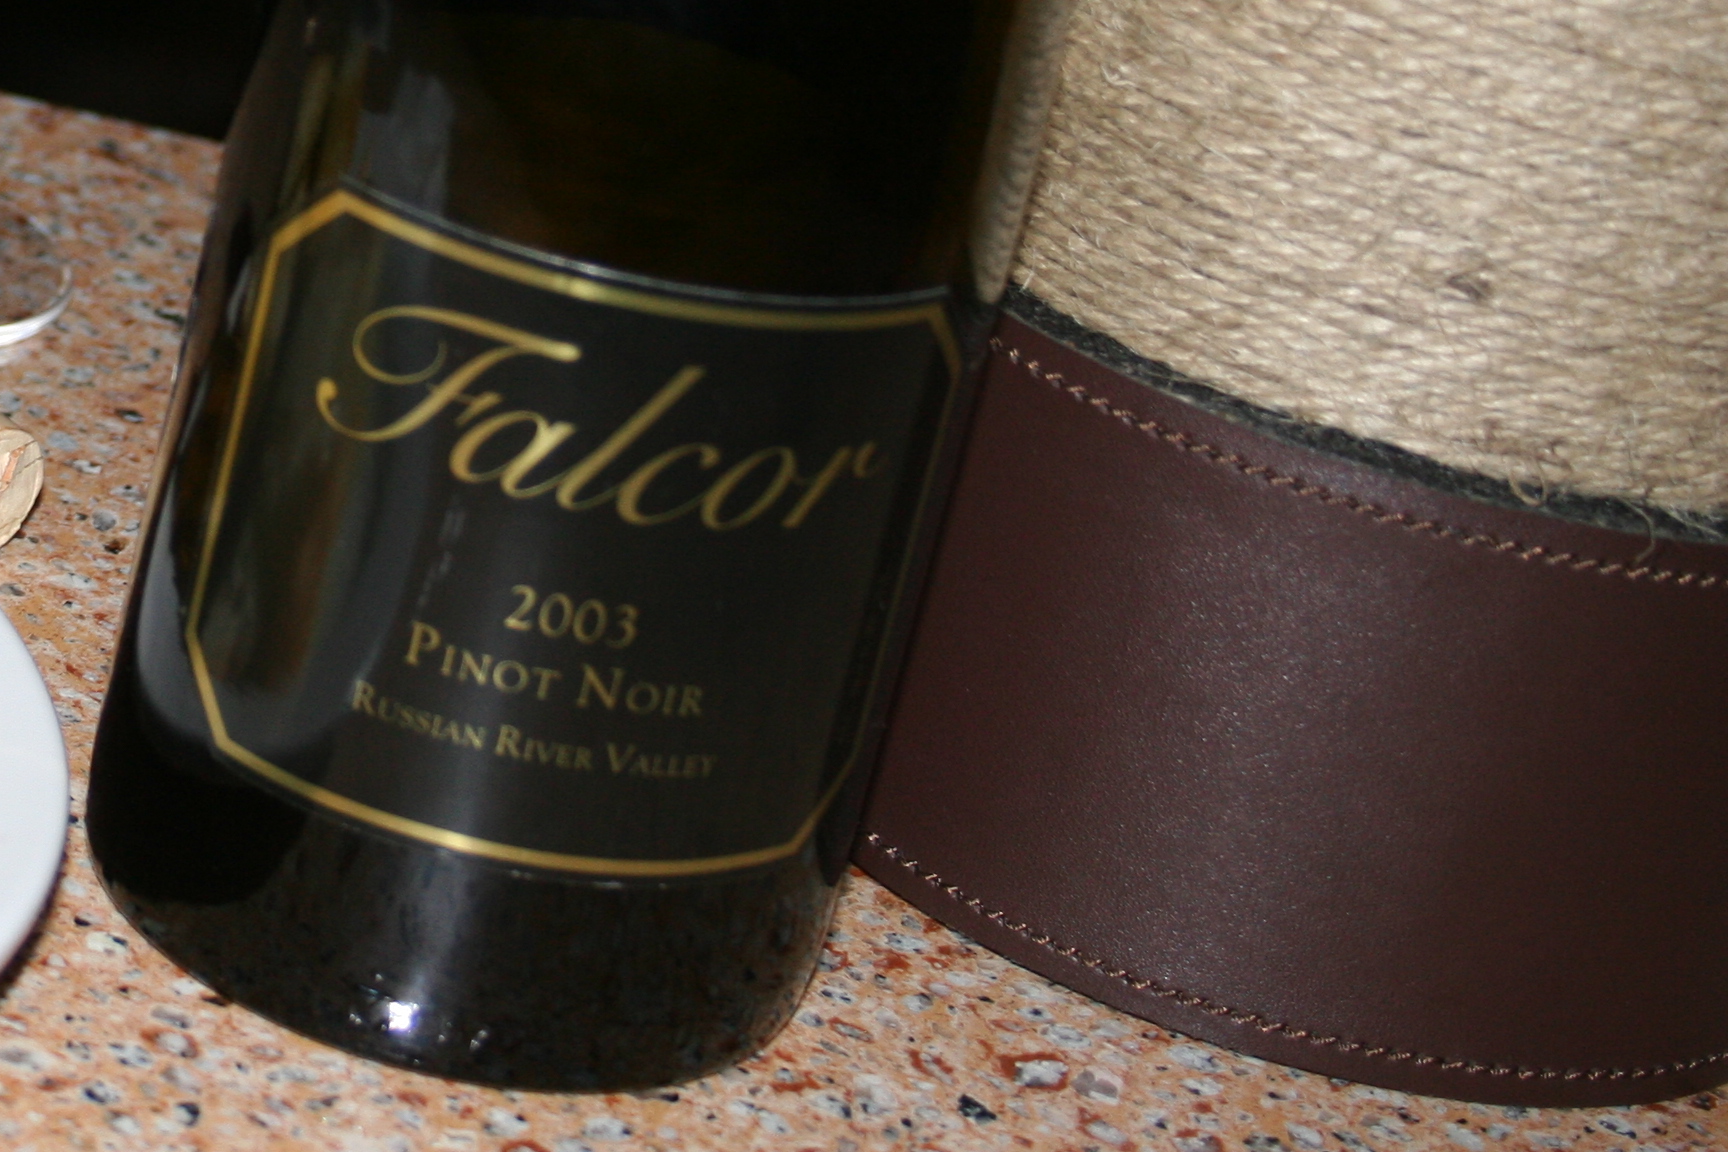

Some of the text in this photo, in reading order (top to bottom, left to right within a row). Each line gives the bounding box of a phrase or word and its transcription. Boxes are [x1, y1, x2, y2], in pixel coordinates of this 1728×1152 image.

[315, 304, 877, 531] Falcor
[502, 583, 640, 649] 2003
[403, 619, 704, 718] PINOT NOIR
[351, 679, 718, 779] RUSSIAN RIVER VALLEY
